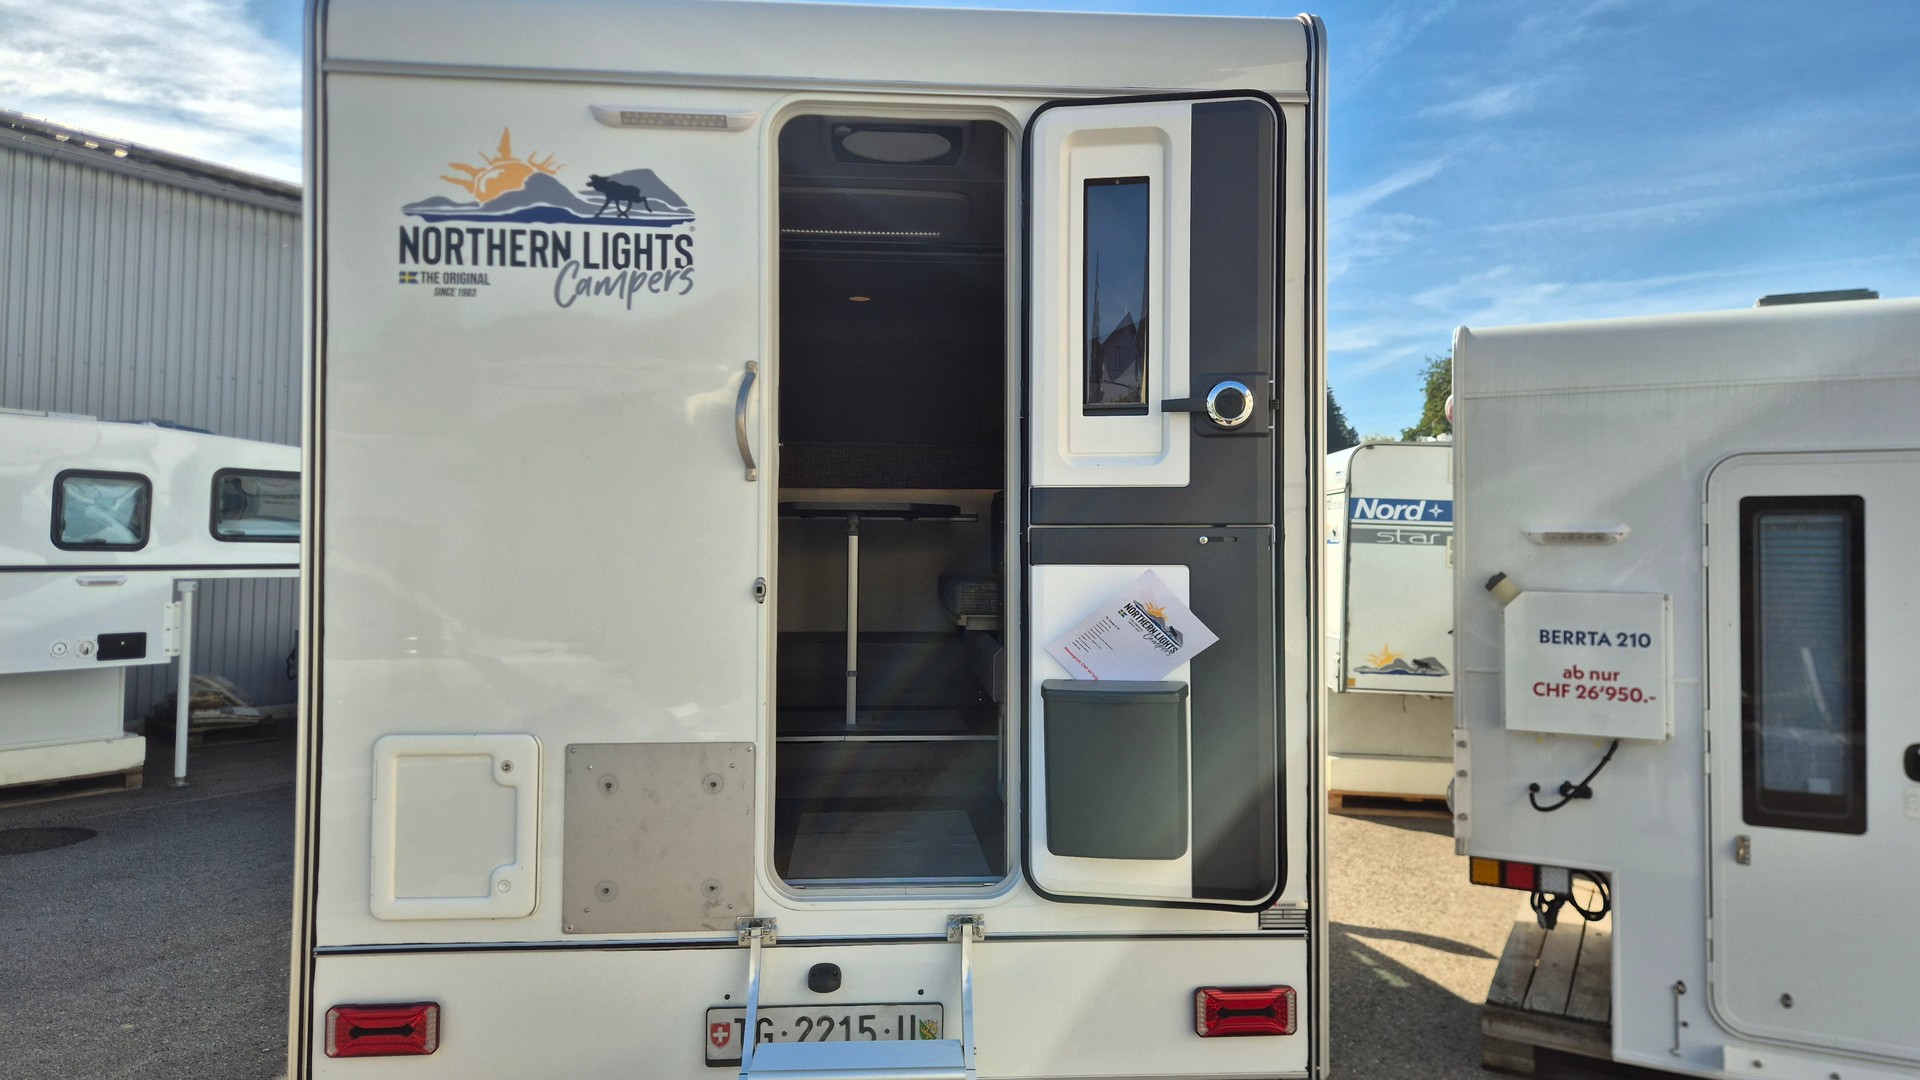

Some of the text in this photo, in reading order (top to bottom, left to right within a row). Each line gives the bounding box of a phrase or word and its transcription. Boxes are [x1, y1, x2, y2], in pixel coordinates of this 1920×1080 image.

[399, 225, 694, 270] NORTHERN LIGHTS
[420, 271, 491, 286] THE ORIGINAL
[554, 259, 695, 310] Campers
[433, 287, 456, 297] SINCE
[1354, 498, 1426, 521] Nord
[1377, 529, 1441, 545] star
[1123, 602, 1158, 634] NORTHERN
[1154, 632, 1179, 654] LIGHTS
[1539, 629, 1652, 649] BERRTA 210
[1562, 664, 1621, 682] ab nur
[1532, 682, 1571, 698] CHF
